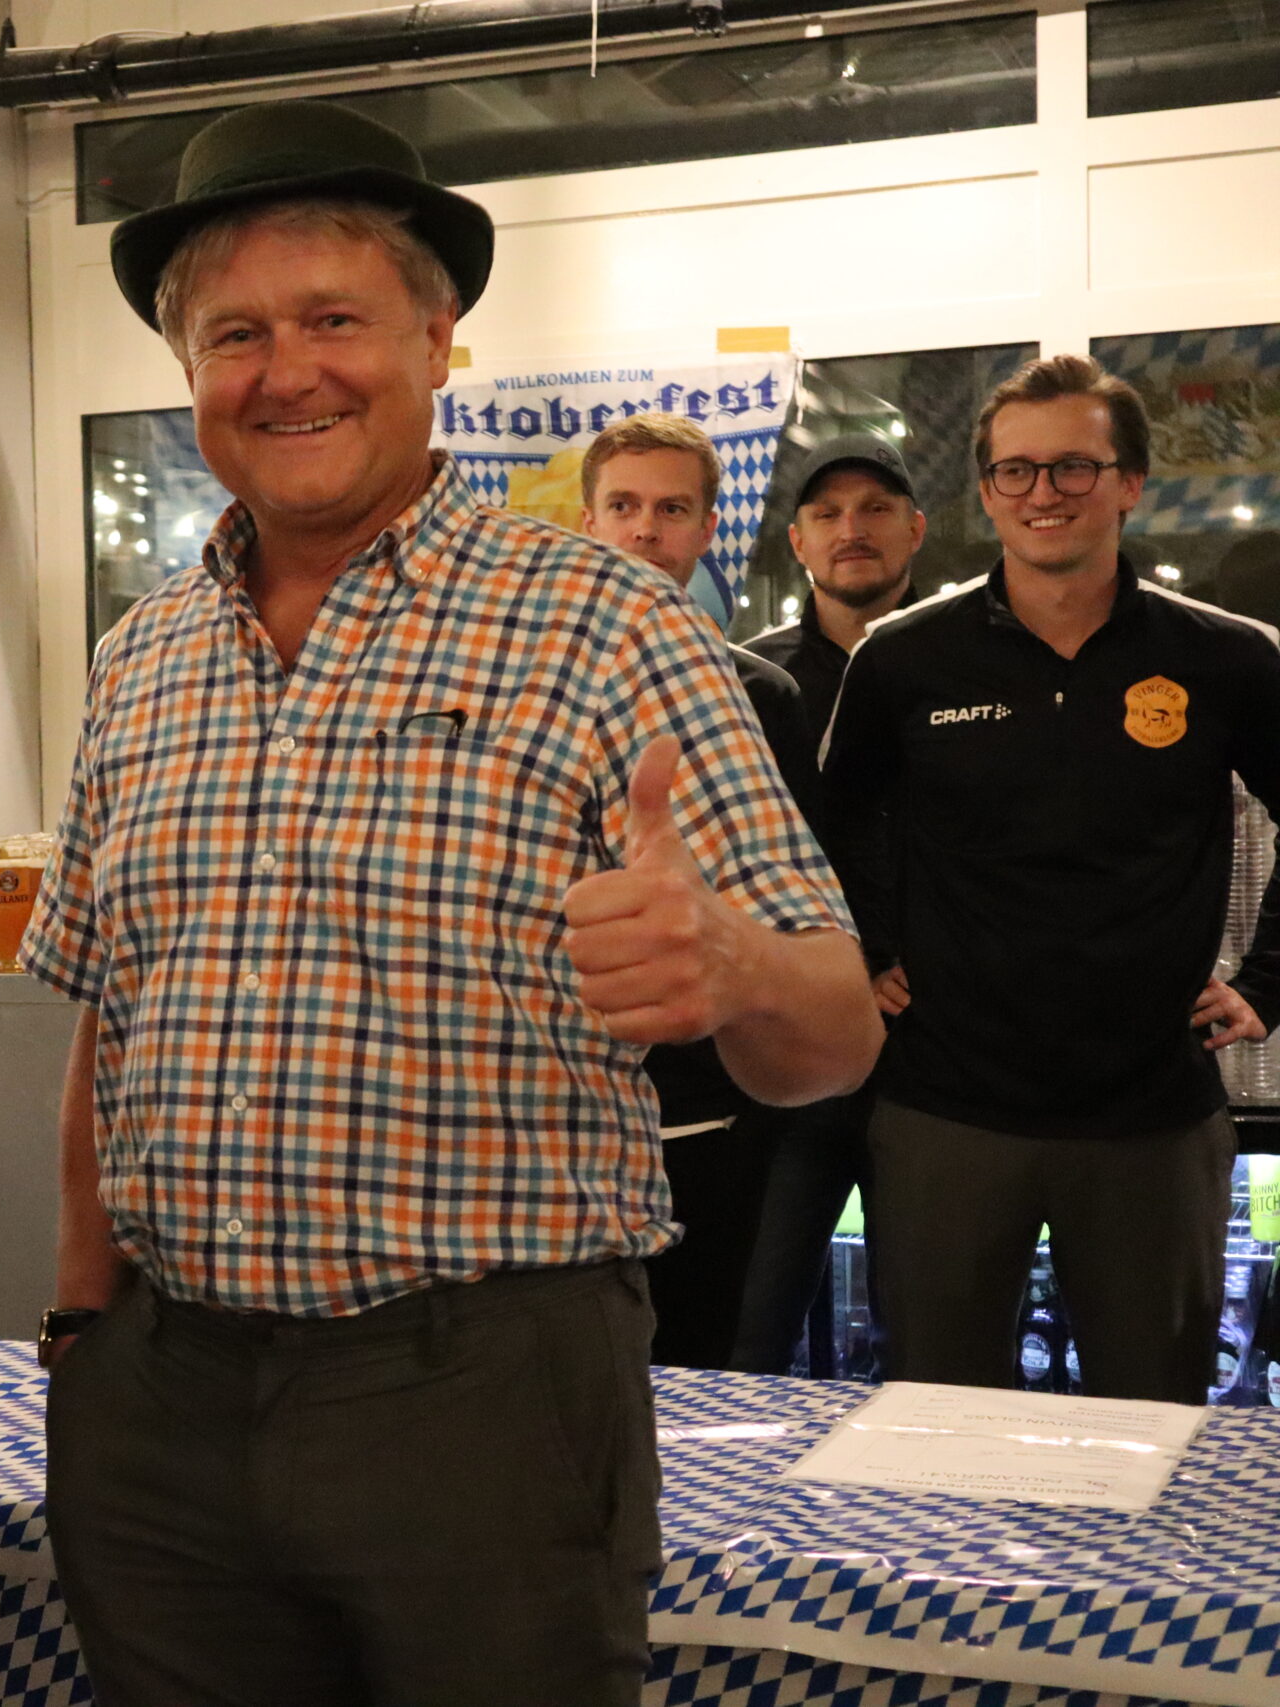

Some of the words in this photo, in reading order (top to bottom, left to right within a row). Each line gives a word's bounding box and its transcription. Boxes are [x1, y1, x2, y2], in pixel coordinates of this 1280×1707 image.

[494, 370, 612, 391] WILLKOMMEN
[617, 369, 654, 382] ZUM
[435, 370, 779, 442] ktoberfest
[1133, 684, 1181, 703] VINGER
[930, 705, 993, 725] CRAFT
